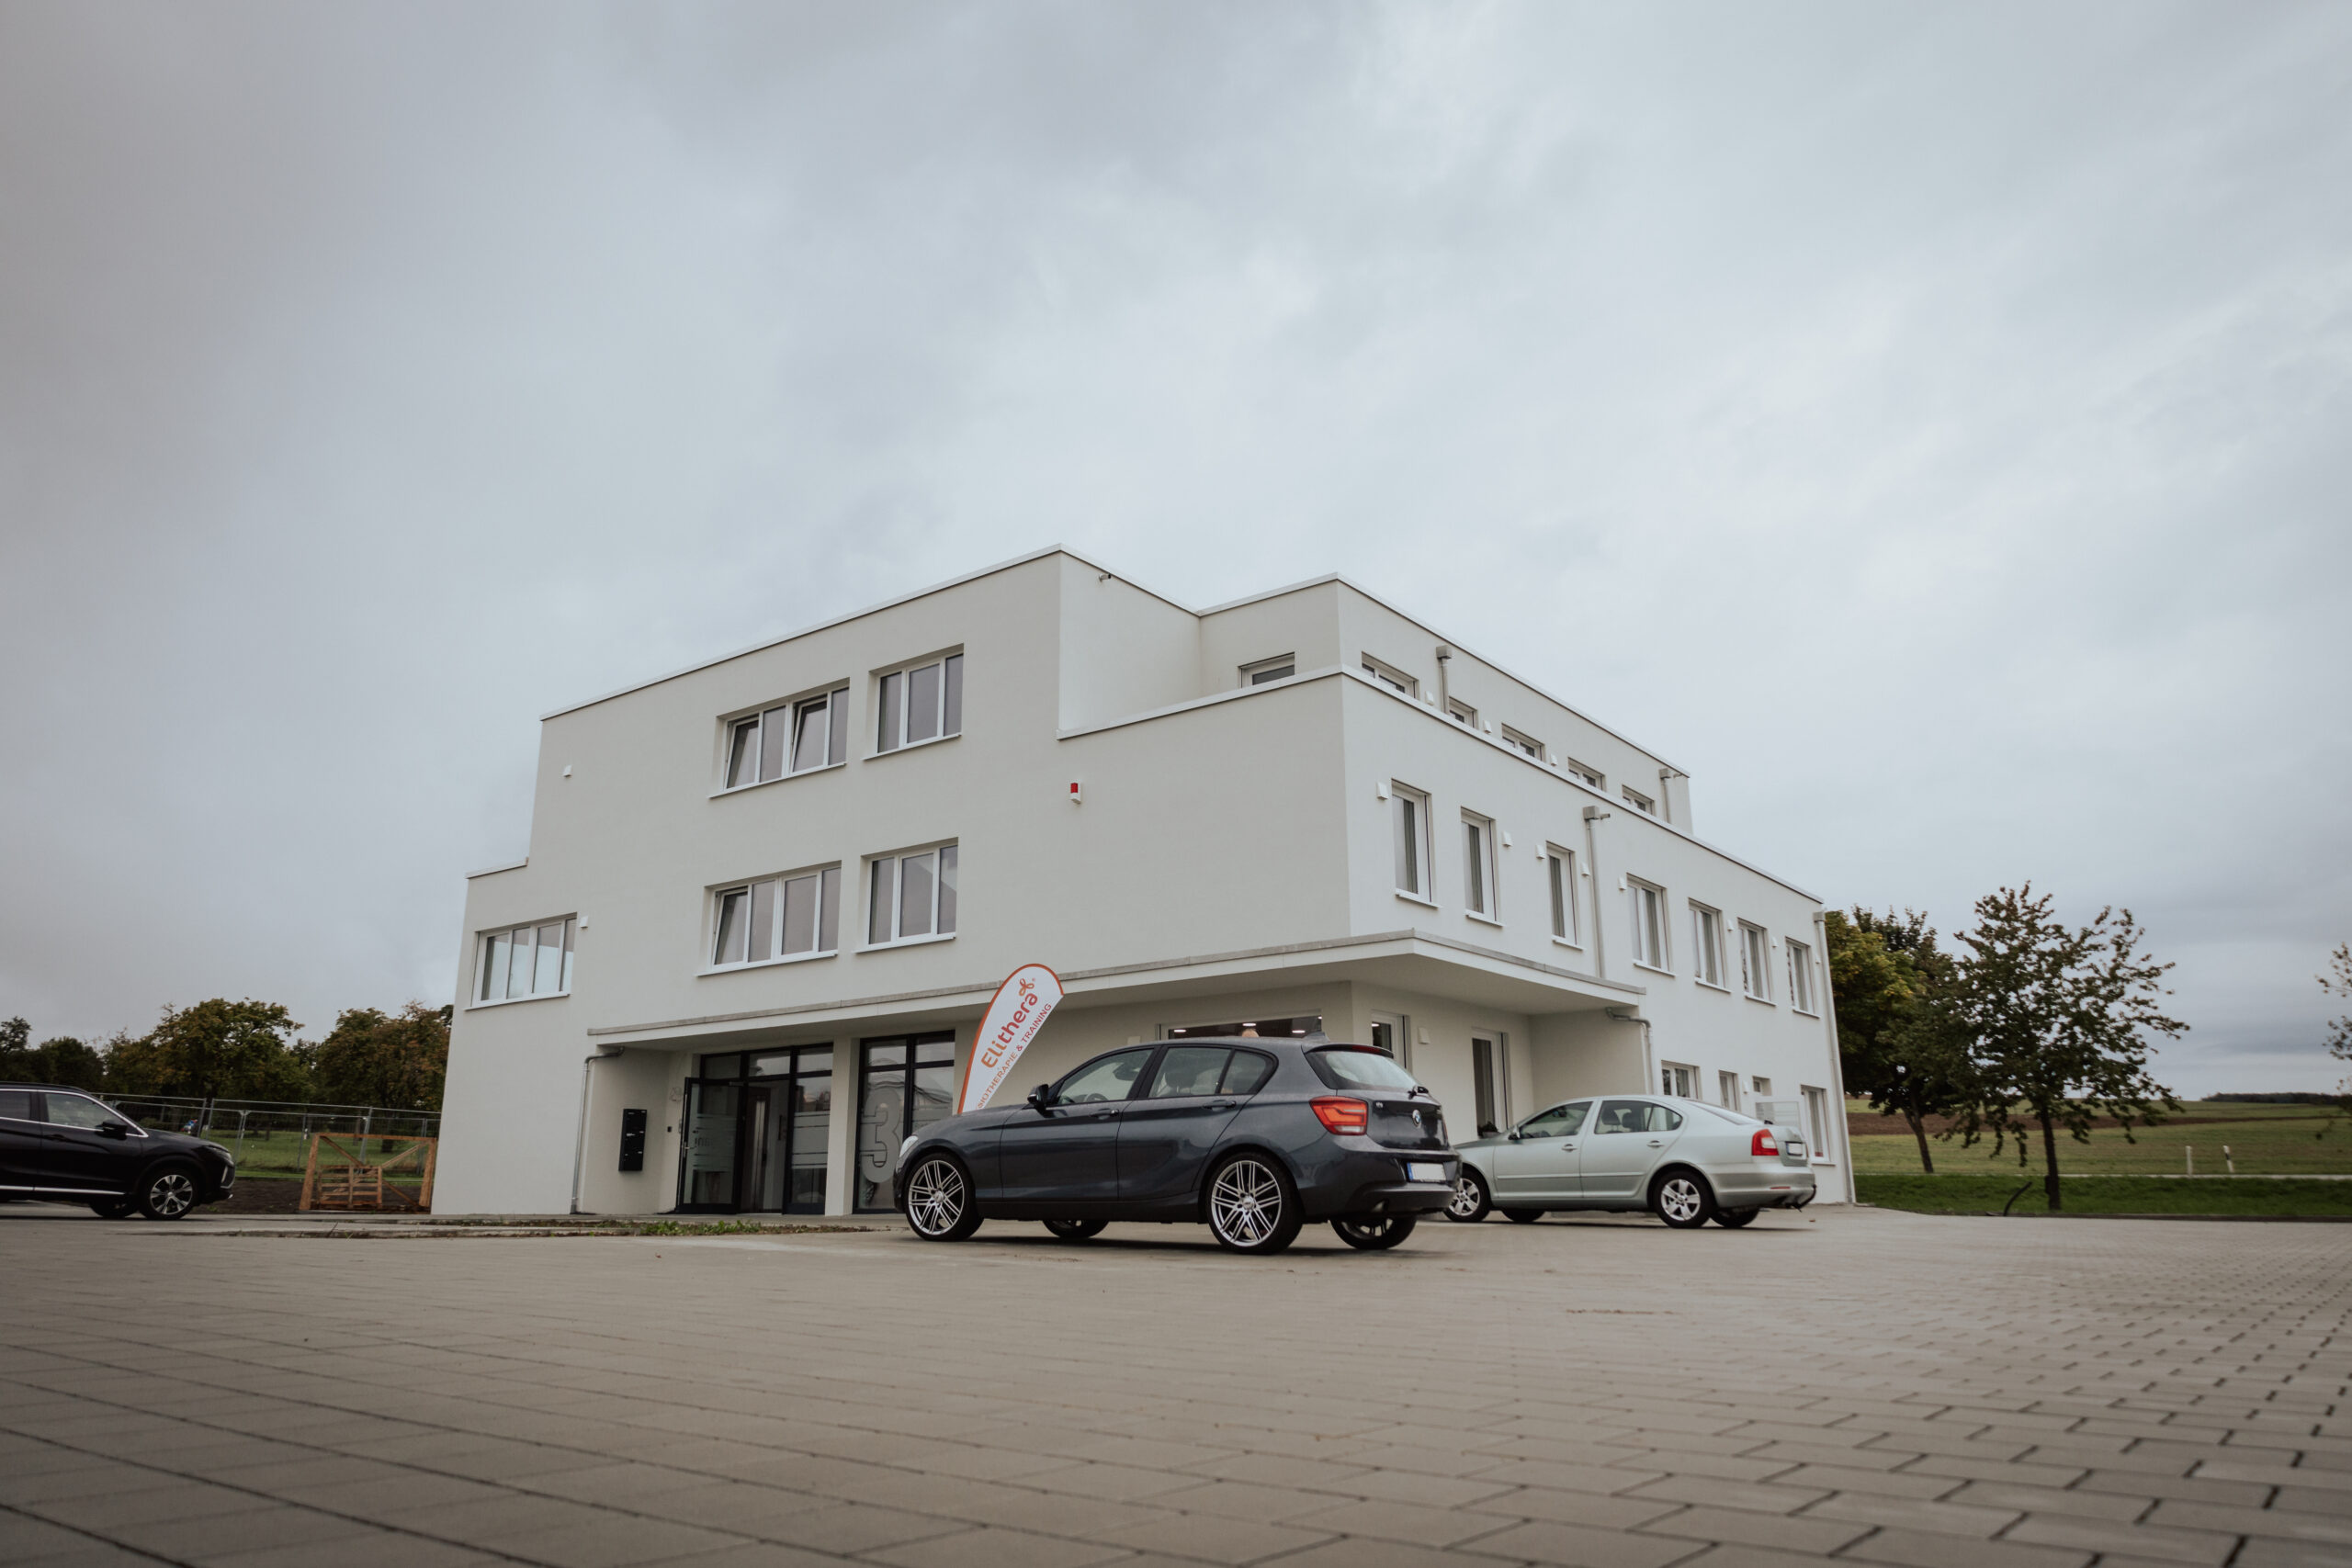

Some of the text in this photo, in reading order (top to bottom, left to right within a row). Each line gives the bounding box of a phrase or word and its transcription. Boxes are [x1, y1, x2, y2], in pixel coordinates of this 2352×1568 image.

[977, 1052, 1018, 1109] SIOTHERAPIE
[1022, 1003, 1052, 1043] TRAINING
[980, 993, 1038, 1068] Elithera
[860, 1089, 900, 1183] 3
